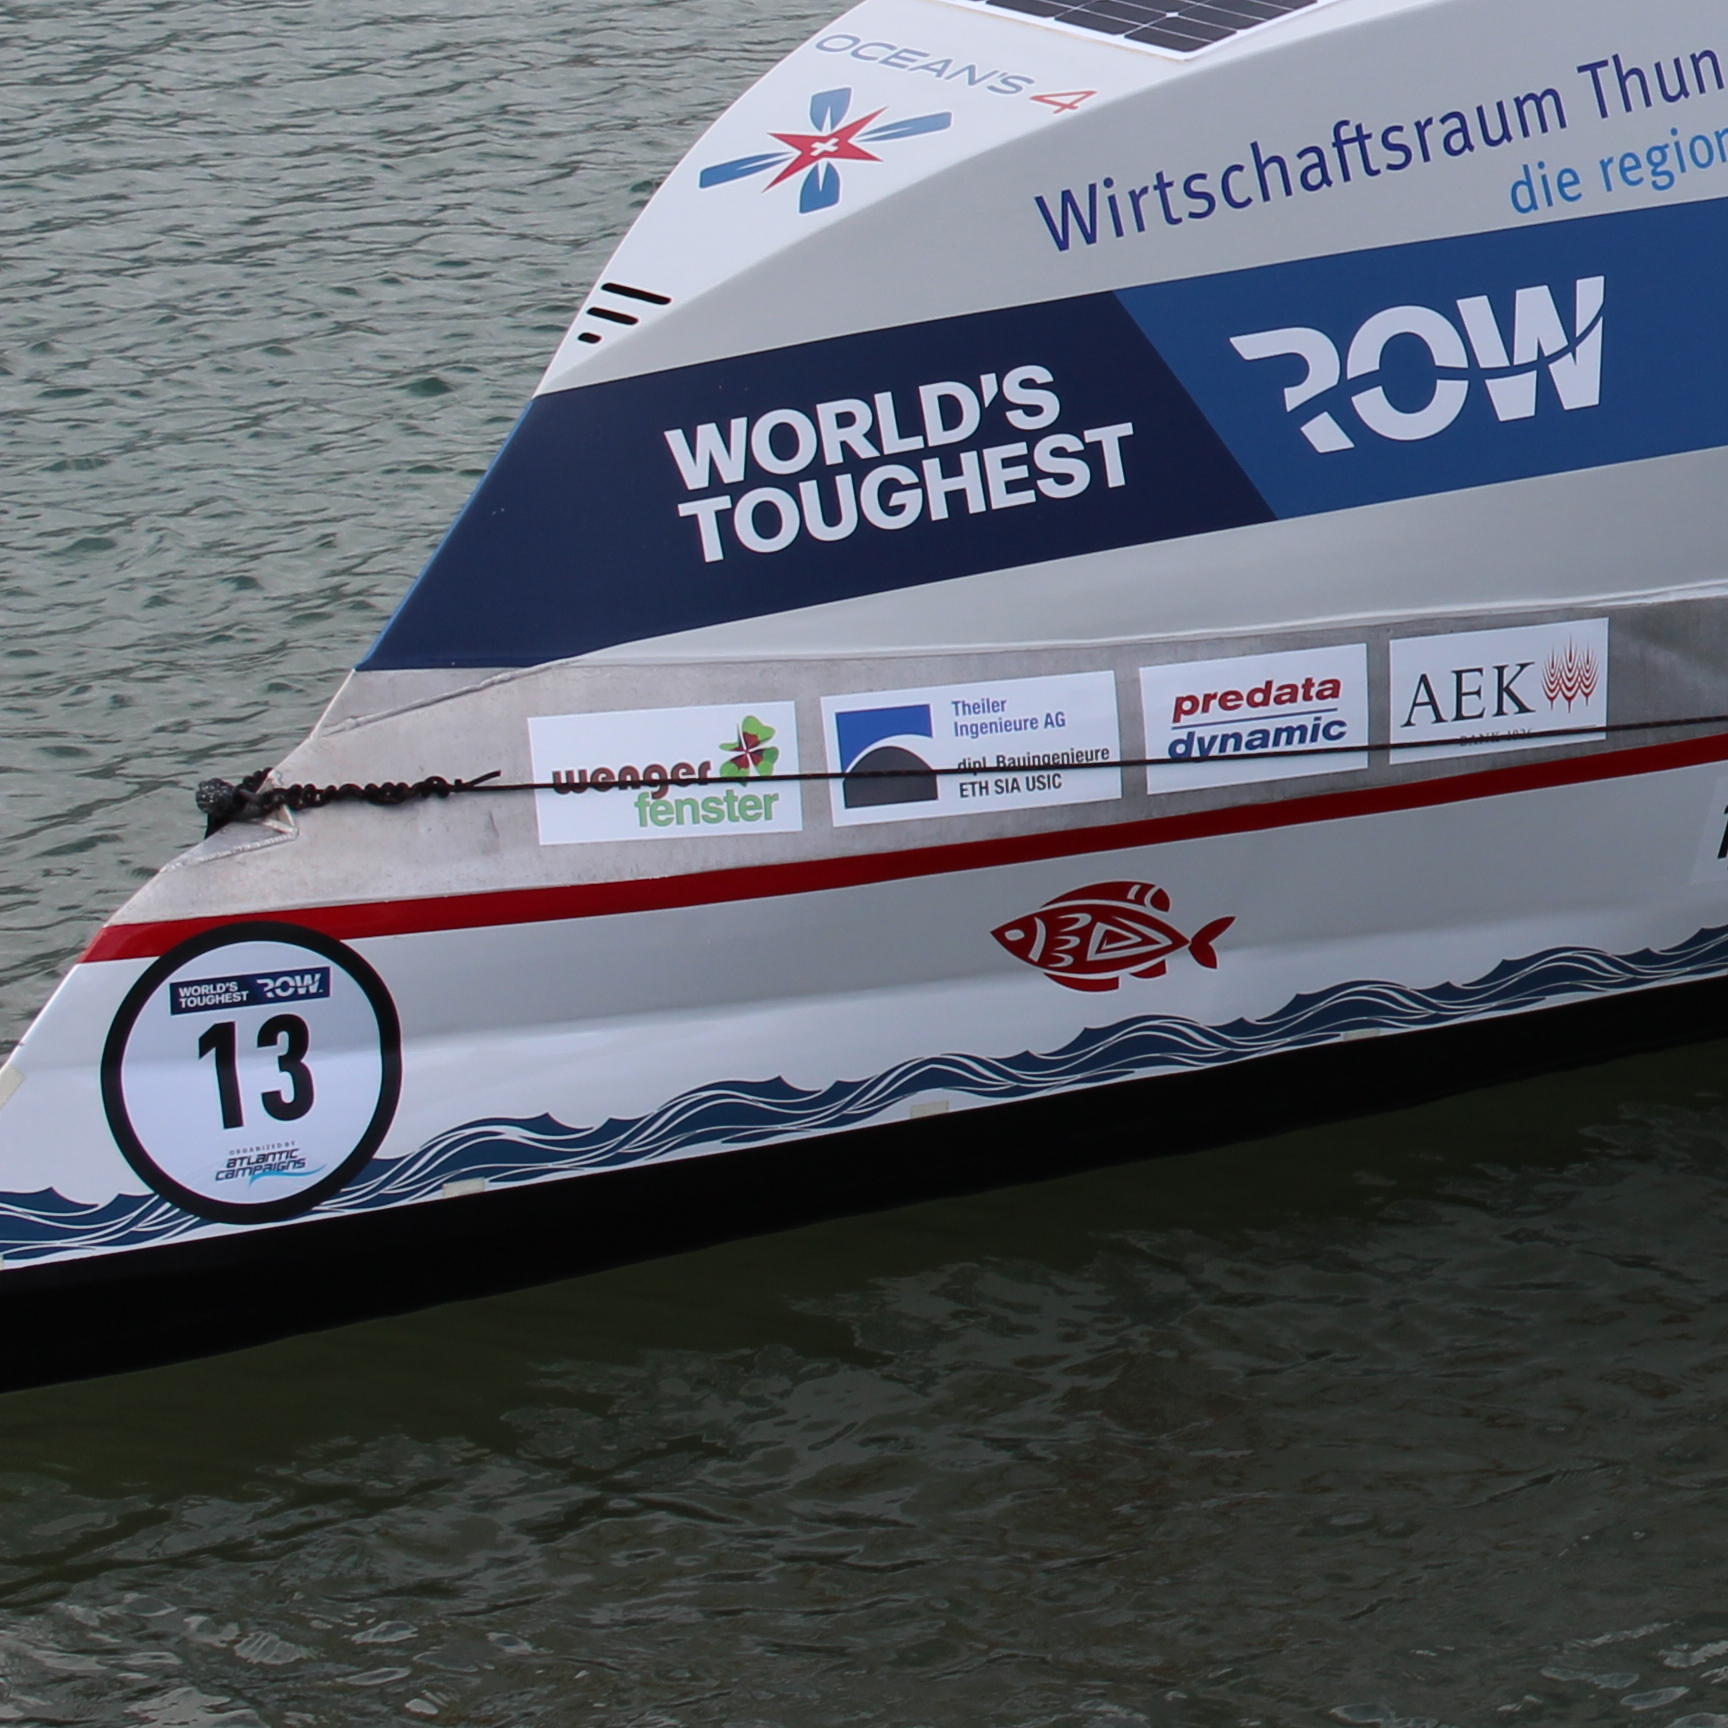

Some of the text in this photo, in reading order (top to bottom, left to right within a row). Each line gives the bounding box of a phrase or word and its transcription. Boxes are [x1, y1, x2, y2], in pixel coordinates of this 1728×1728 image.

[815, 32, 1098, 115] OCEAN'S 4
[1033, 47, 1727, 255] Wirtschaftsraum Thun
[1509, 161, 1584, 216] die
[1228, 275, 1606, 455] ROW
[663, 363, 1062, 492] WORLD'S
[676, 421, 1135, 564] TOUGHEST
[951, 697, 1008, 718] Theiler
[1171, 675, 1342, 724] predata
[1399, 659, 1538, 729] AEK
[953, 710, 1067, 740] Ingenieure AG
[1167, 715, 1350, 763] dynamic
[633, 787, 781, 828] fenster
[958, 772, 1064, 800] ETH SIA USIC
[178, 980, 240, 998] WORLD'S
[179, 990, 250, 1010] TOUGHEST
[256, 973, 323, 999] ROW
[198, 1013, 316, 1131] 13
[228, 1142, 284, 1156] ORGANIZED
